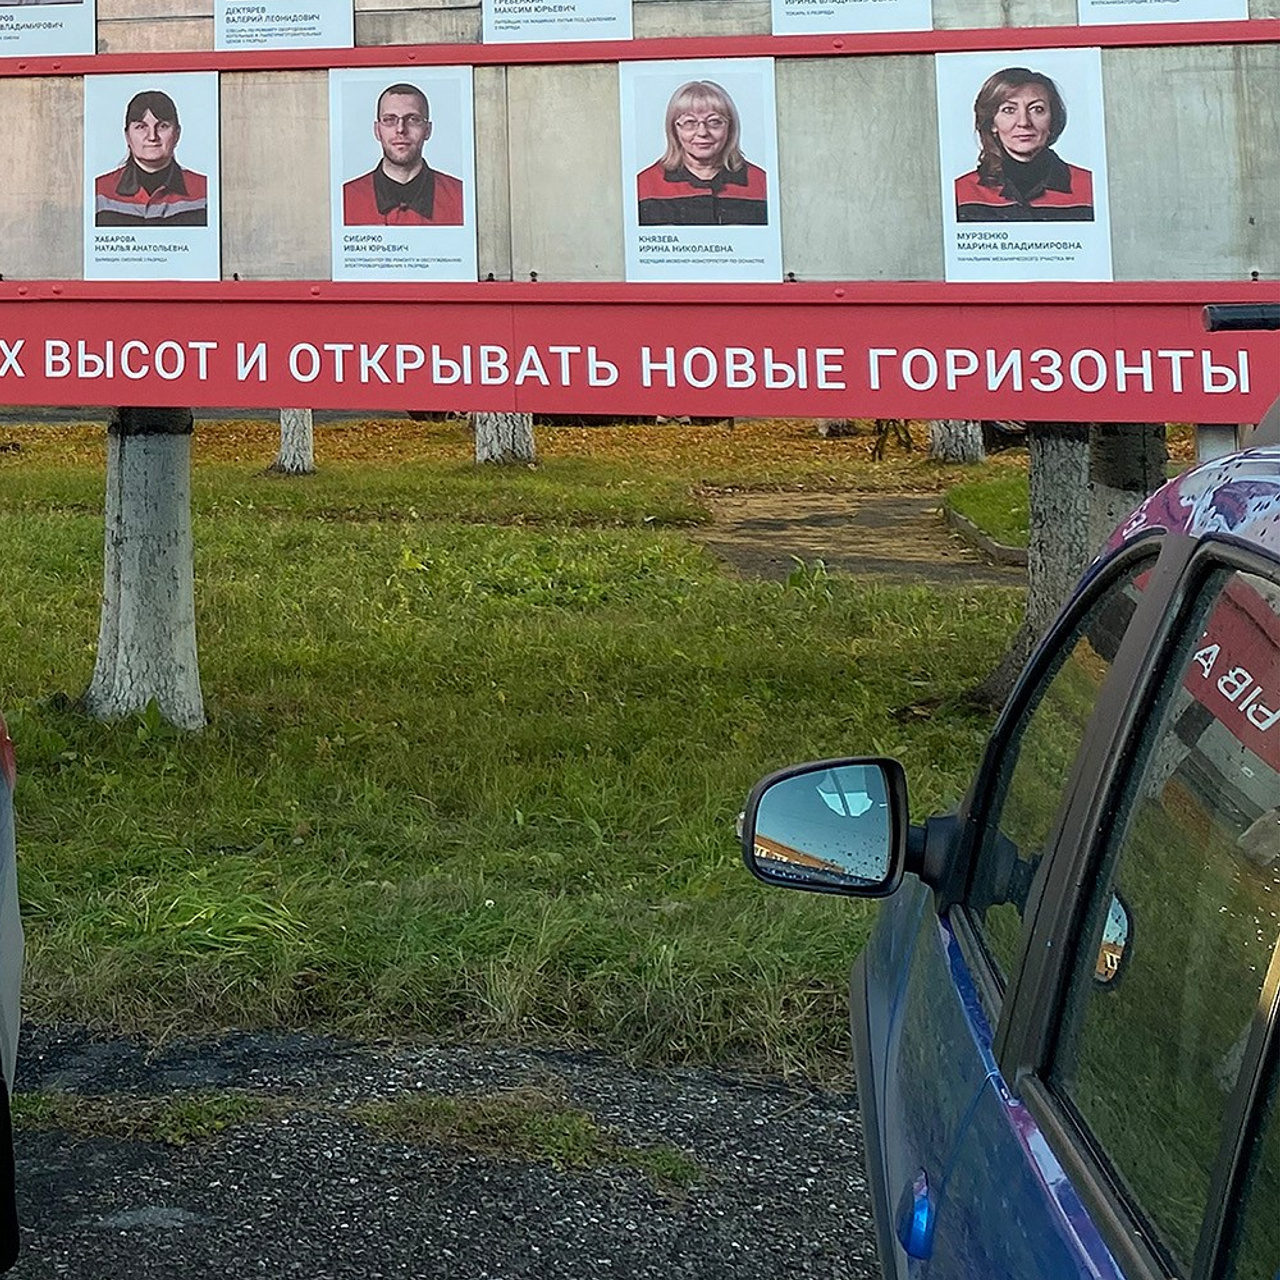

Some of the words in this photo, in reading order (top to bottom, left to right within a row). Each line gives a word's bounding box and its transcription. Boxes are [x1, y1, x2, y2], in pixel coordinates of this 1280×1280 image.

[225, 6, 266, 15] ДЕХТЯРЕВ
[494, 6, 532, 14] МАКСИМ
[534, 5, 576, 13] ЮРЬЕВИЧ
[225, 15, 263, 23] ВАЛЕРИЙ
[265, 14, 320, 23] ЛЕОНИДОВИЧ
[0, 22, 63, 31] ВЛАДИМИРОВИЧ
[95, 235, 136, 243] ХАБАРОВА
[343, 235, 382, 243] СИБИРКО
[639, 235, 679, 243] КНЯЗЕВА
[957, 232, 1008, 240] МУРЗЕНКО
[639, 245, 670, 253] ИРИНА
[672, 245, 733, 253] НИКОЛАЕВНА
[957, 242, 999, 250] МАРИНА
[1001, 241, 1082, 251] ВЛАДИМИРОВНА
[44, 339, 218, 381] ВЫСОТ
[236, 342, 267, 382] И
[289, 341, 619, 388] ОТКРЫВАТЬ
[641, 345, 845, 390] НОВЫЕ
[869, 347, 1251, 394] ГОРИЗОНТЫ
